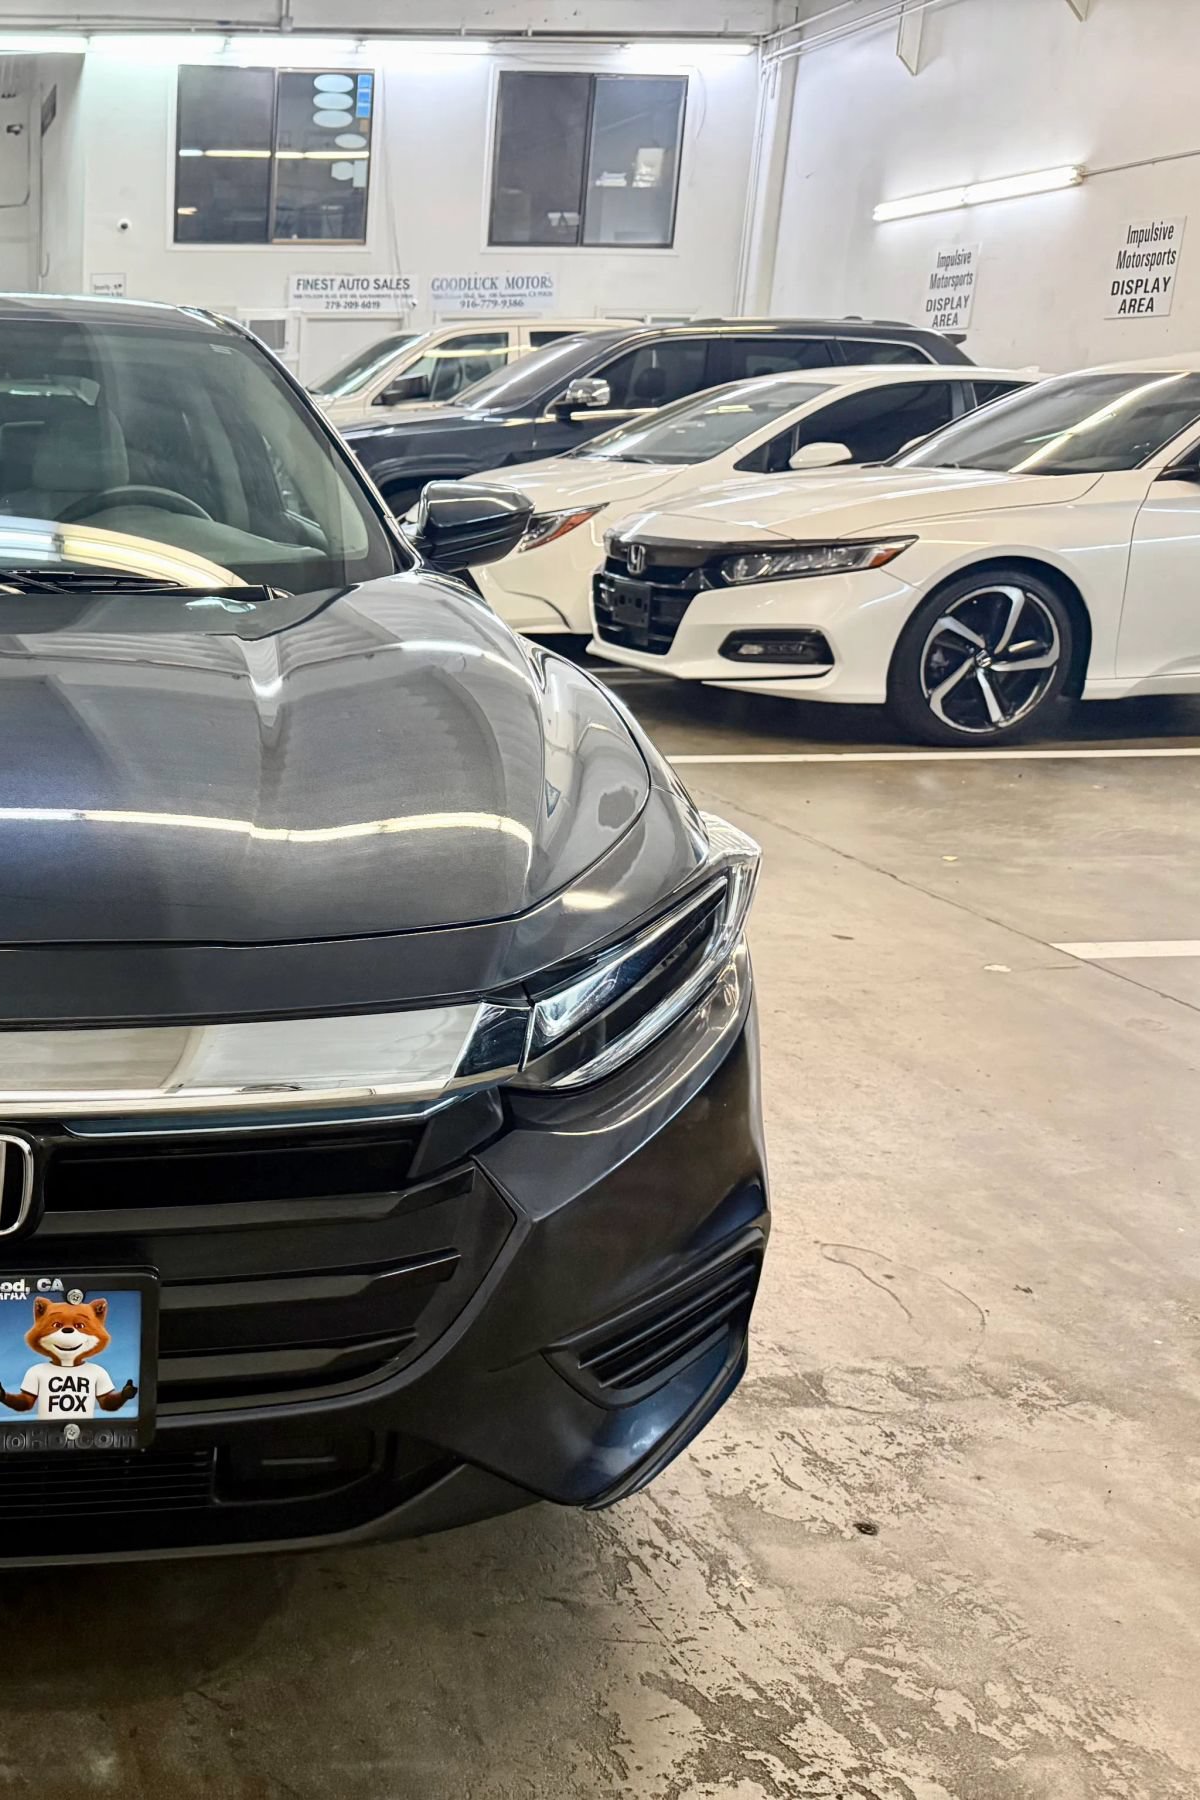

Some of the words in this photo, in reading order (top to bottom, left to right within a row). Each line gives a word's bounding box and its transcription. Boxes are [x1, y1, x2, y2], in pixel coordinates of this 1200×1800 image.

[1127, 221, 1174, 248] Impulsive
[937, 248, 972, 271] Impulsive
[1116, 248, 1177, 272] Motorsports
[296, 278, 336, 291] FINEST
[338, 278, 370, 291] AUTO
[373, 278, 411, 290] SALES
[431, 276, 499, 292] GOODLUCK
[505, 275, 554, 290] MOTORS
[929, 270, 973, 291] Motorsports
[1111, 276, 1171, 296] DISPLAY
[925, 294, 970, 313] DISPLAY
[1118, 297, 1154, 315] AREA
[932, 312, 959, 328] AREA
[37, 1278, 64, 1292] CA
[48, 1376, 90, 1393] CAR
[48, 1394, 87, 1412] FOX
